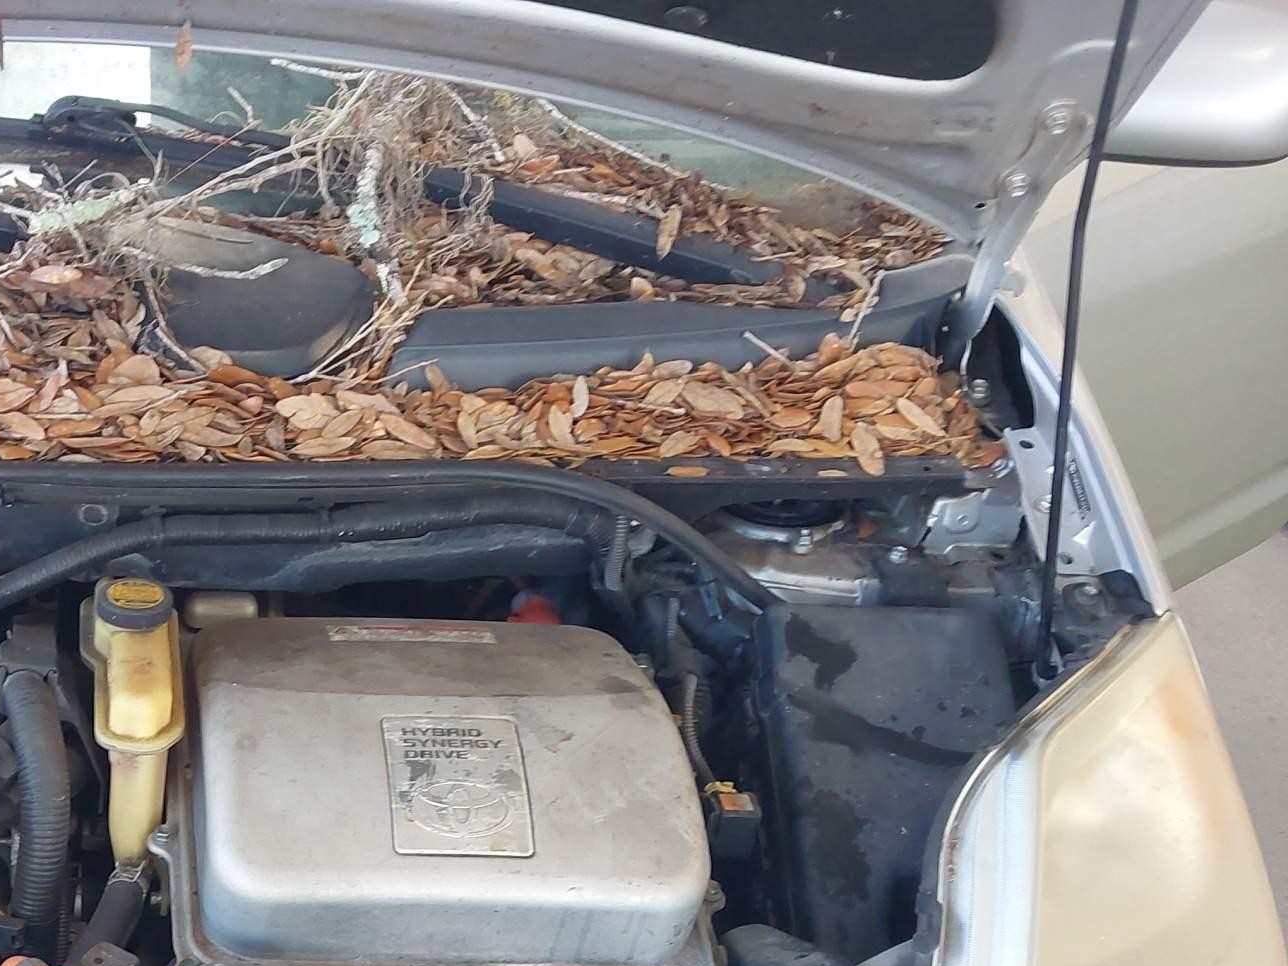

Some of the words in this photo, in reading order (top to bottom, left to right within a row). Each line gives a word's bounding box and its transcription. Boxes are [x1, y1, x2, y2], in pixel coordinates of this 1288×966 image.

[400, 727, 482, 738] HYBRID
[402, 738, 503, 749] SYNERGY
[403, 749, 469, 760] DRIVE
